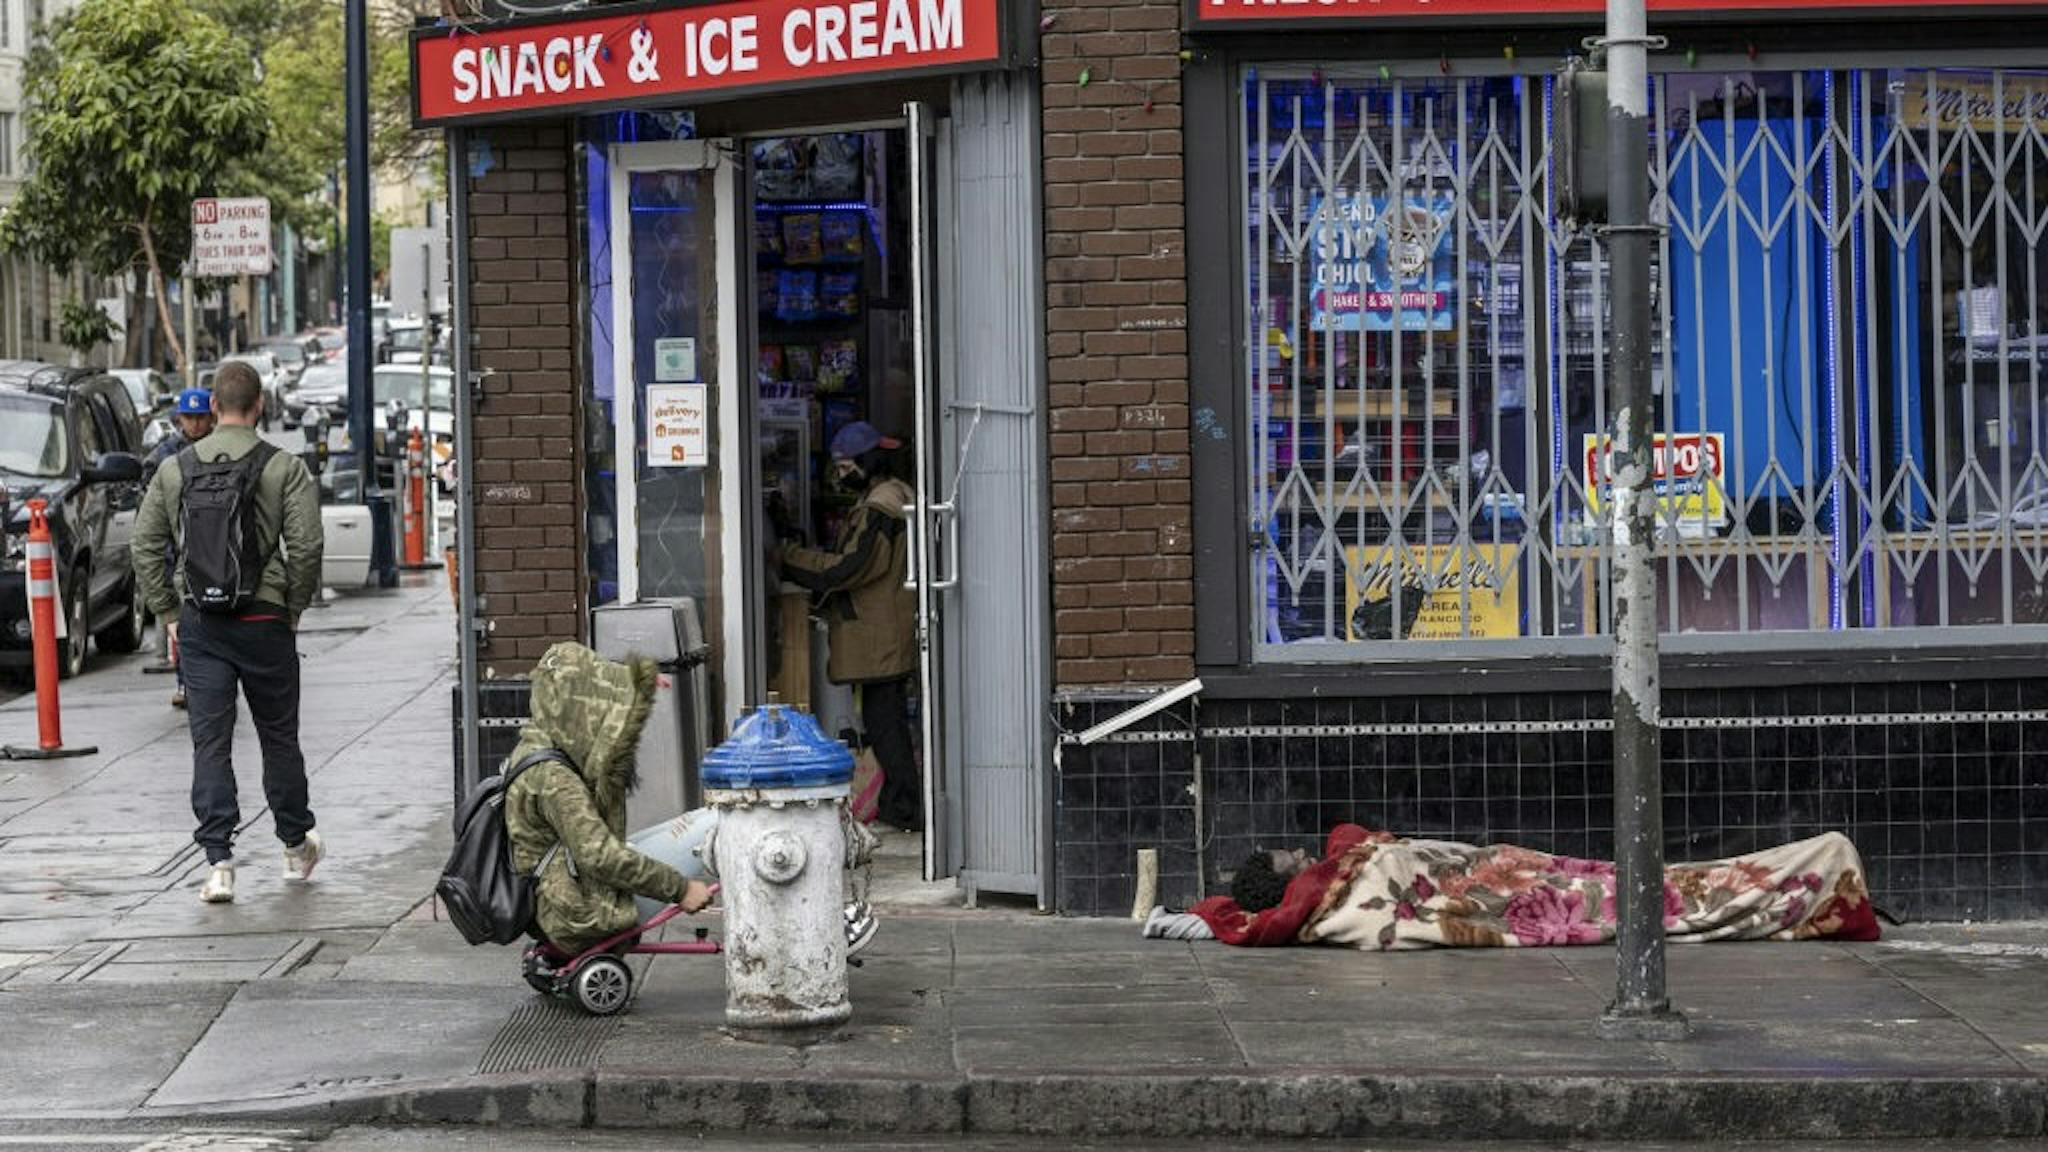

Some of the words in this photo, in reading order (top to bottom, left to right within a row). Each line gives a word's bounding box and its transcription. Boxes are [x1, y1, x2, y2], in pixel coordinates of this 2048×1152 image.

[452, 33, 605, 103] SNACK
[627, 28, 660, 84] &
[685, 15, 758, 77] ICE
[782, 0, 965, 67] CREAM
[197, 203, 215, 222] NO
[220, 206, 265, 218] PARKING
[1331, 295, 1361, 307] HAKE
[1368, 296, 1377, 307] &
[1379, 294, 1437, 307] SMOTHIS
